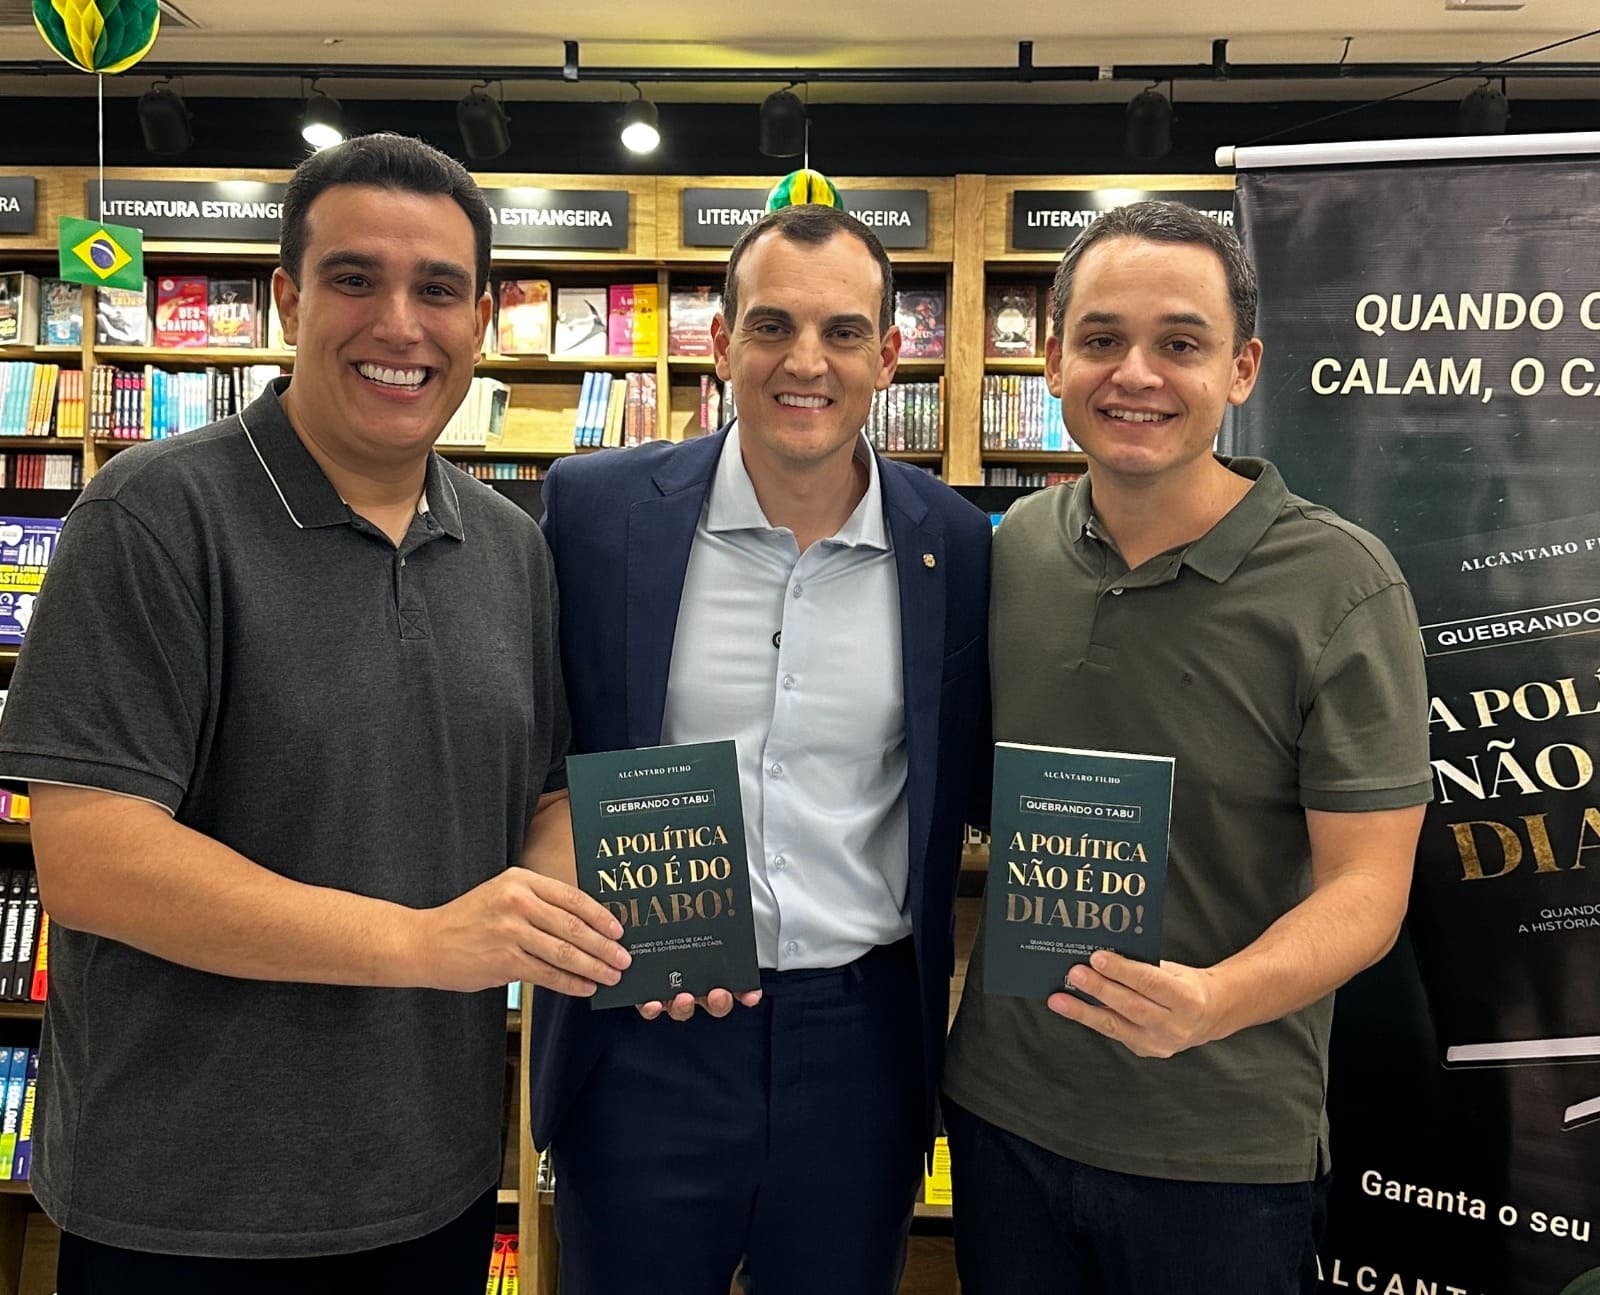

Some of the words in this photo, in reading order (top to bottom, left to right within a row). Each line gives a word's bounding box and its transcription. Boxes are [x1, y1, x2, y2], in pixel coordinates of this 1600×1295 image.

[103, 200, 200, 218] LITERATURA
[500, 207, 613, 227] ESTRANGEIRA
[1355, 292, 1564, 336] QUANDO
[1310, 357, 1494, 403] CALAM,
[1510, 358, 1546, 396] O
[1560, 358, 1600, 396] C
[1460, 542, 1578, 572] ALCÂNTARO
[1437, 608, 1600, 646] QUEBRANDO
[1428, 697, 1467, 735] A
[1429, 737, 1594, 804] NÃO
[606, 798, 670, 813] QUEBRANDO
[672, 797, 680, 807] O
[682, 794, 709, 805] TABU
[1026, 800, 1092, 816] QUEBRANDO
[1094, 806, 1103, 816] O
[1105, 807, 1134, 819] TABU
[596, 838, 613, 859] A
[616, 824, 729, 856] POLÍTICA
[1008, 831, 1026, 852] A
[1031, 832, 1148, 863] POLÍTICA
[597, 860, 658, 893] NÃO
[664, 855, 683, 886] É
[688, 856, 733, 883] DO
[1007, 858, 1069, 890] NÃO
[1075, 863, 1094, 893] É
[1100, 871, 1146, 897] DO
[604, 887, 737, 928] DIABO!
[1005, 893, 1144, 935] DIABO!
[1518, 924, 1529, 934] A
[1531, 917, 1600, 932] HISTÓRIA
[1361, 1169, 1486, 1221] Garanta
[1499, 1205, 1518, 1226] o
[1530, 1210, 1591, 1242] seu
